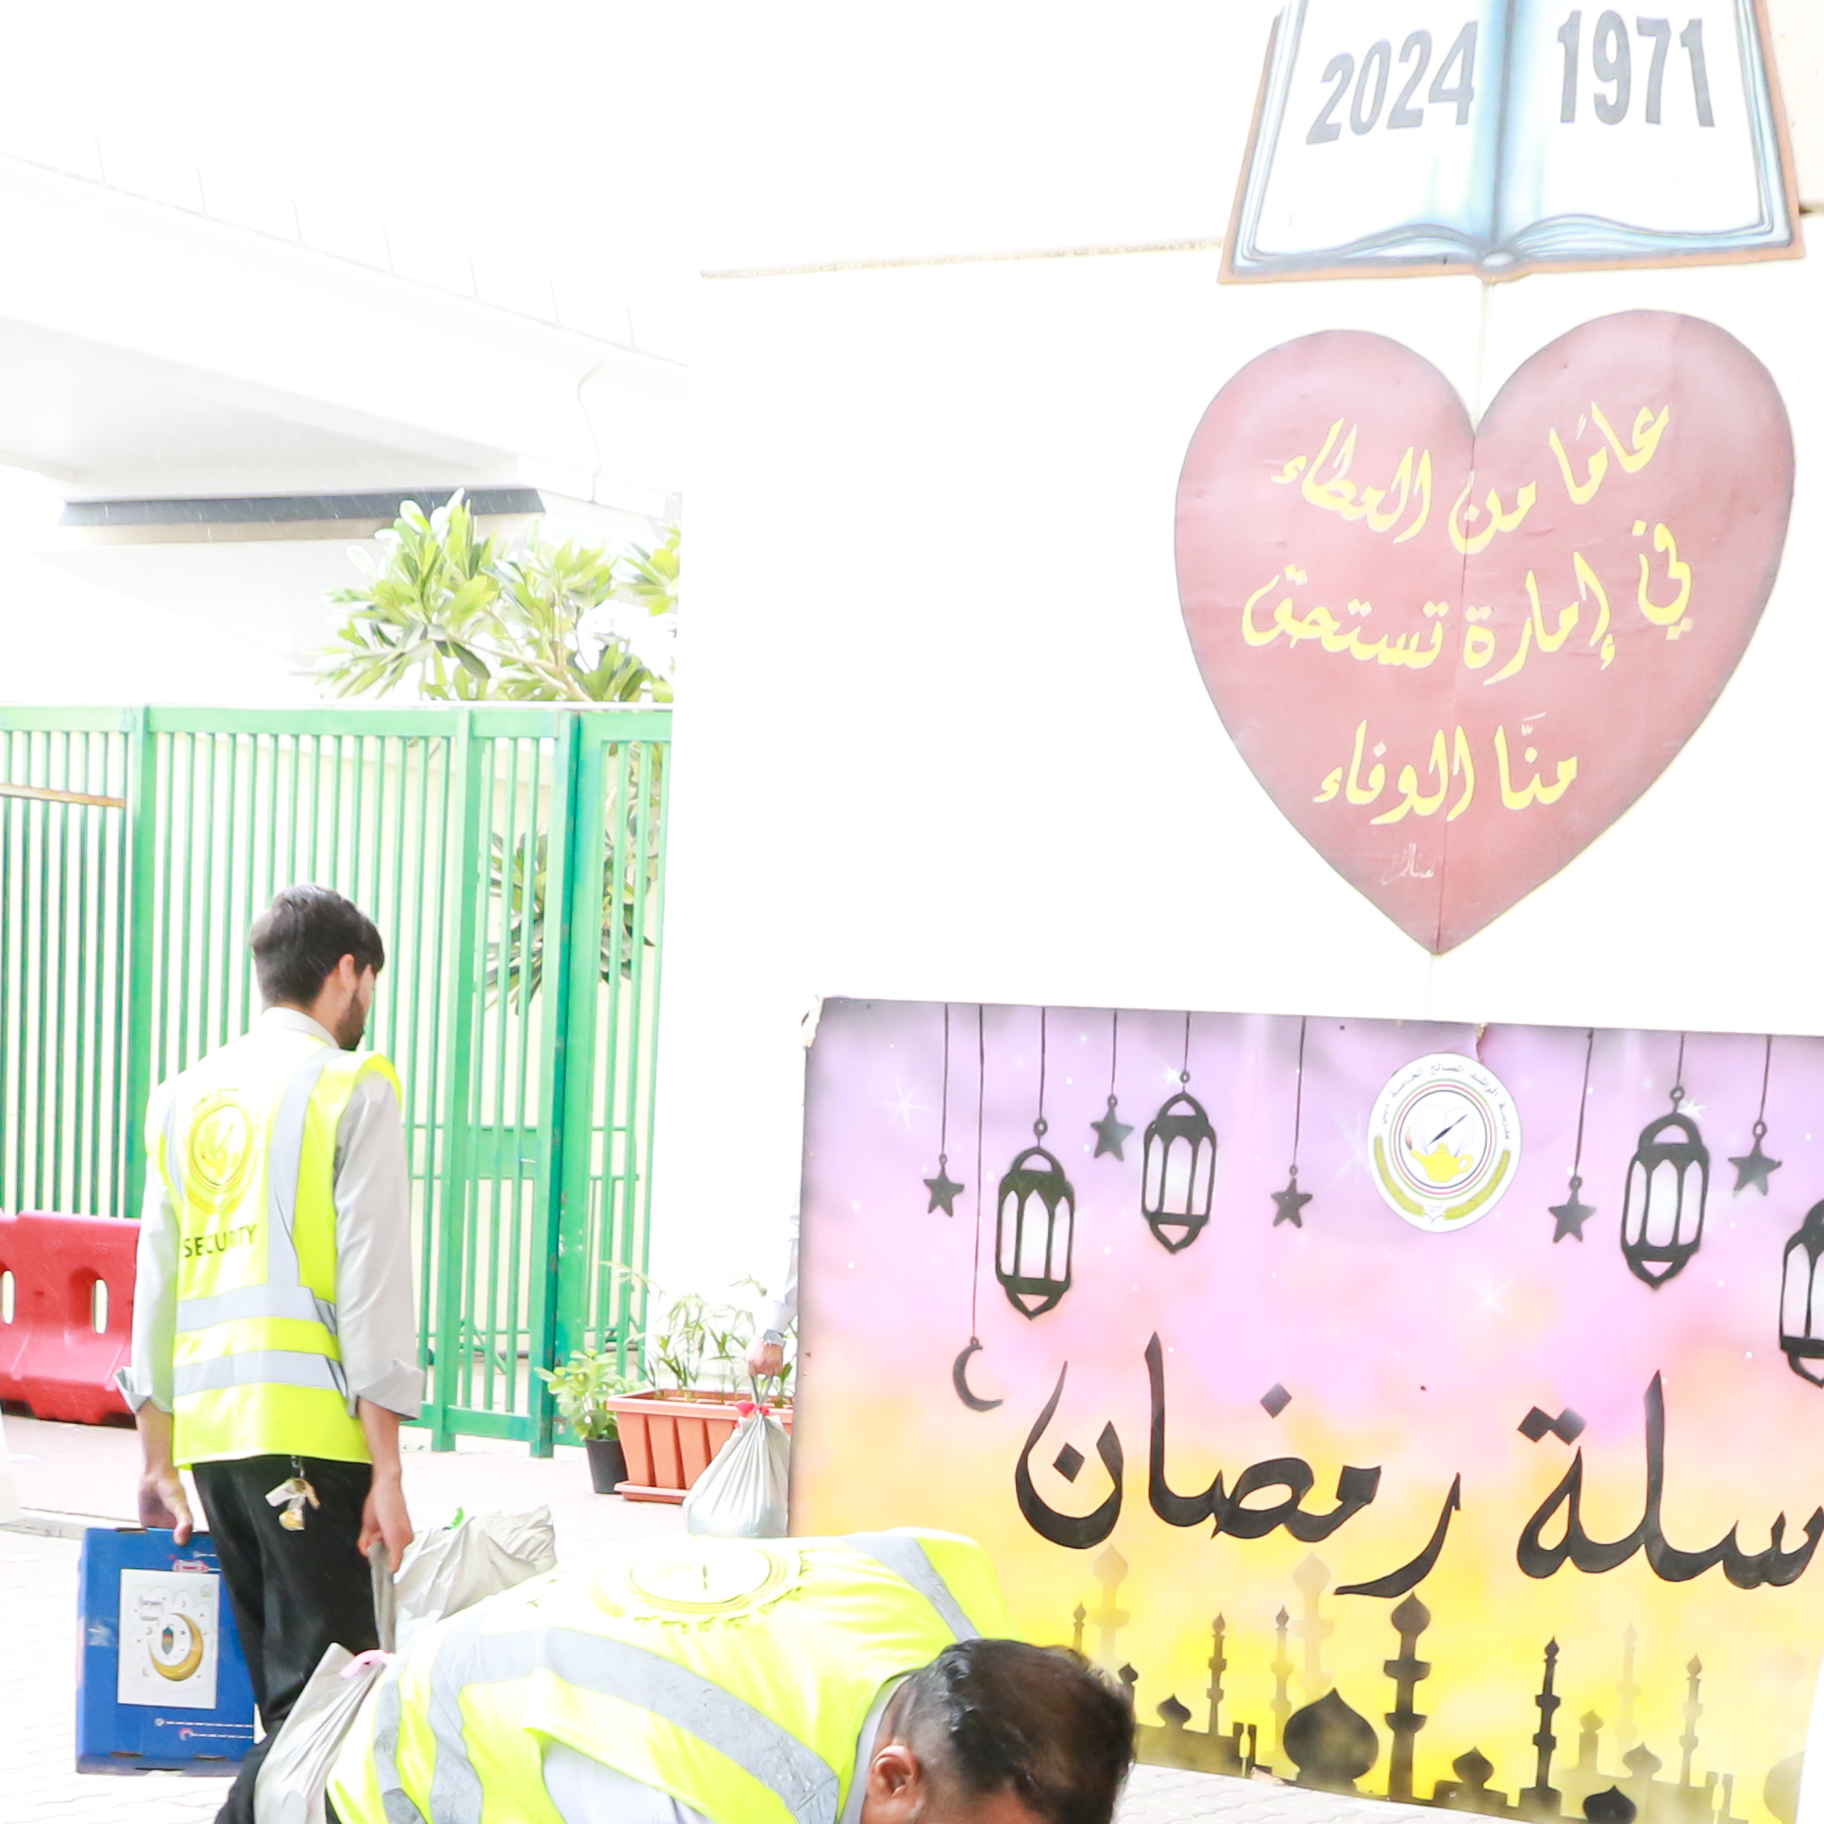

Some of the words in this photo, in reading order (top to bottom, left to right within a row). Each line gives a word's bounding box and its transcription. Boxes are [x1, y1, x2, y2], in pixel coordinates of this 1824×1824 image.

[1305, 20, 1479, 146] 2024
[1555, 9, 1716, 129] 1971
[1270, 415, 1434, 543] العطاء
[1447, 468, 1538, 555] من
[1239, 564, 1449, 671] تستحق
[1462, 551, 1619, 686] إمارة
[1633, 517, 1695, 641] في
[1313, 717, 1477, 827] الوفاء
[1013, 1330, 1461, 1600] رمضان
